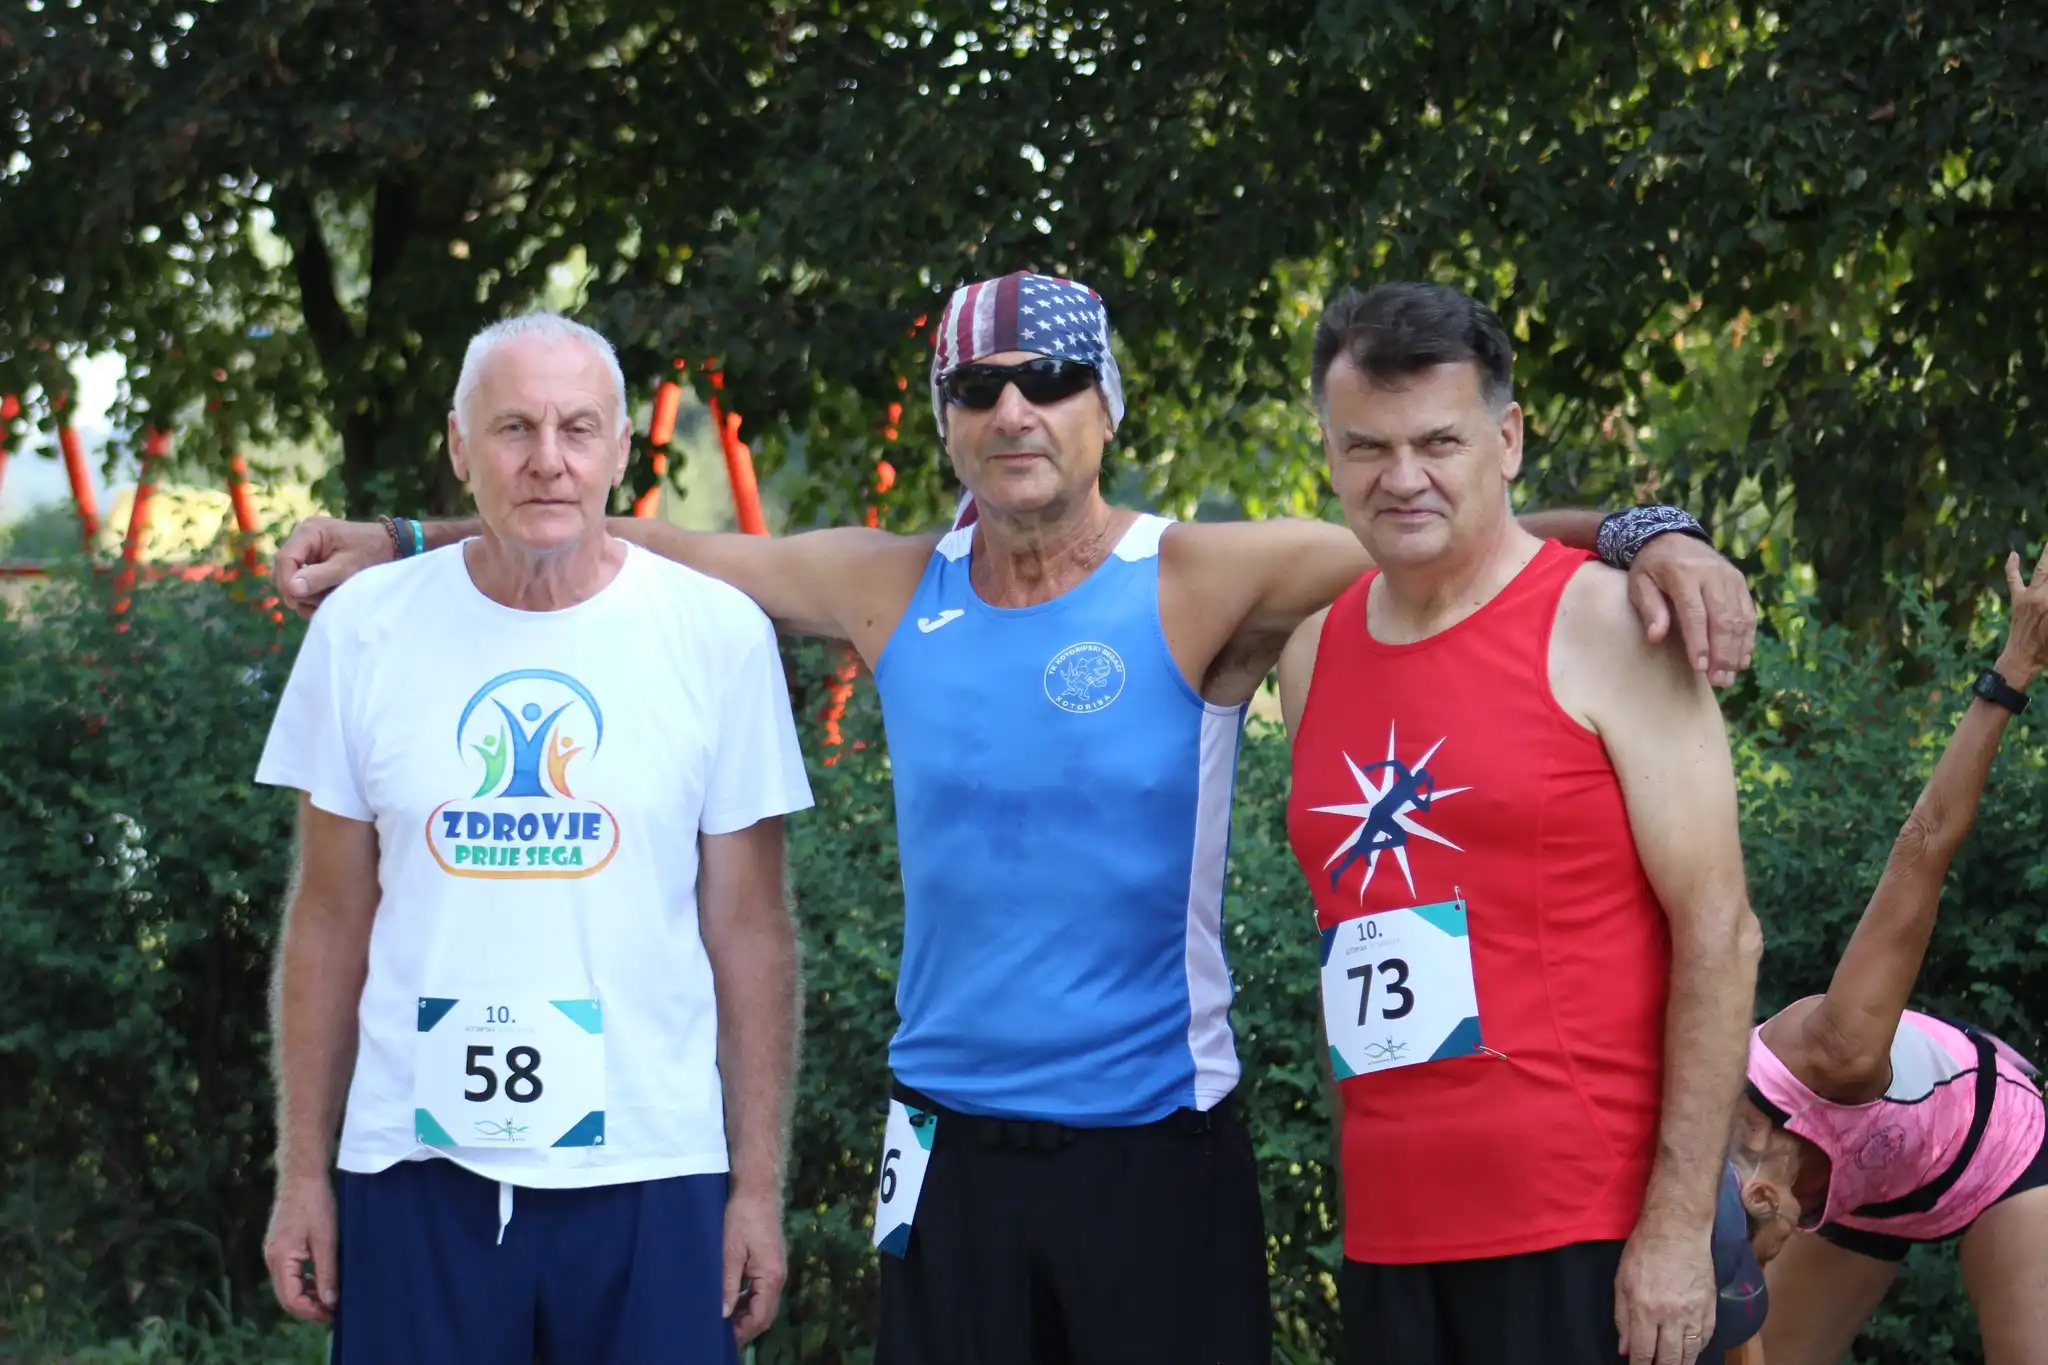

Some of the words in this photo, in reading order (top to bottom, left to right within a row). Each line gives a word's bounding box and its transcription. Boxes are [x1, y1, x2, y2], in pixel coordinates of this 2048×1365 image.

[1055, 695, 1111, 711] KOTORIBA
[443, 811, 602, 842] ZDROVJE
[455, 845, 521, 866] PRIJE
[525, 846, 583, 866] SEGA
[1357, 920, 1383, 942] 10.
[1347, 958, 1414, 1027] 73
[486, 1006, 516, 1024] 10.
[464, 1045, 544, 1104] 58
